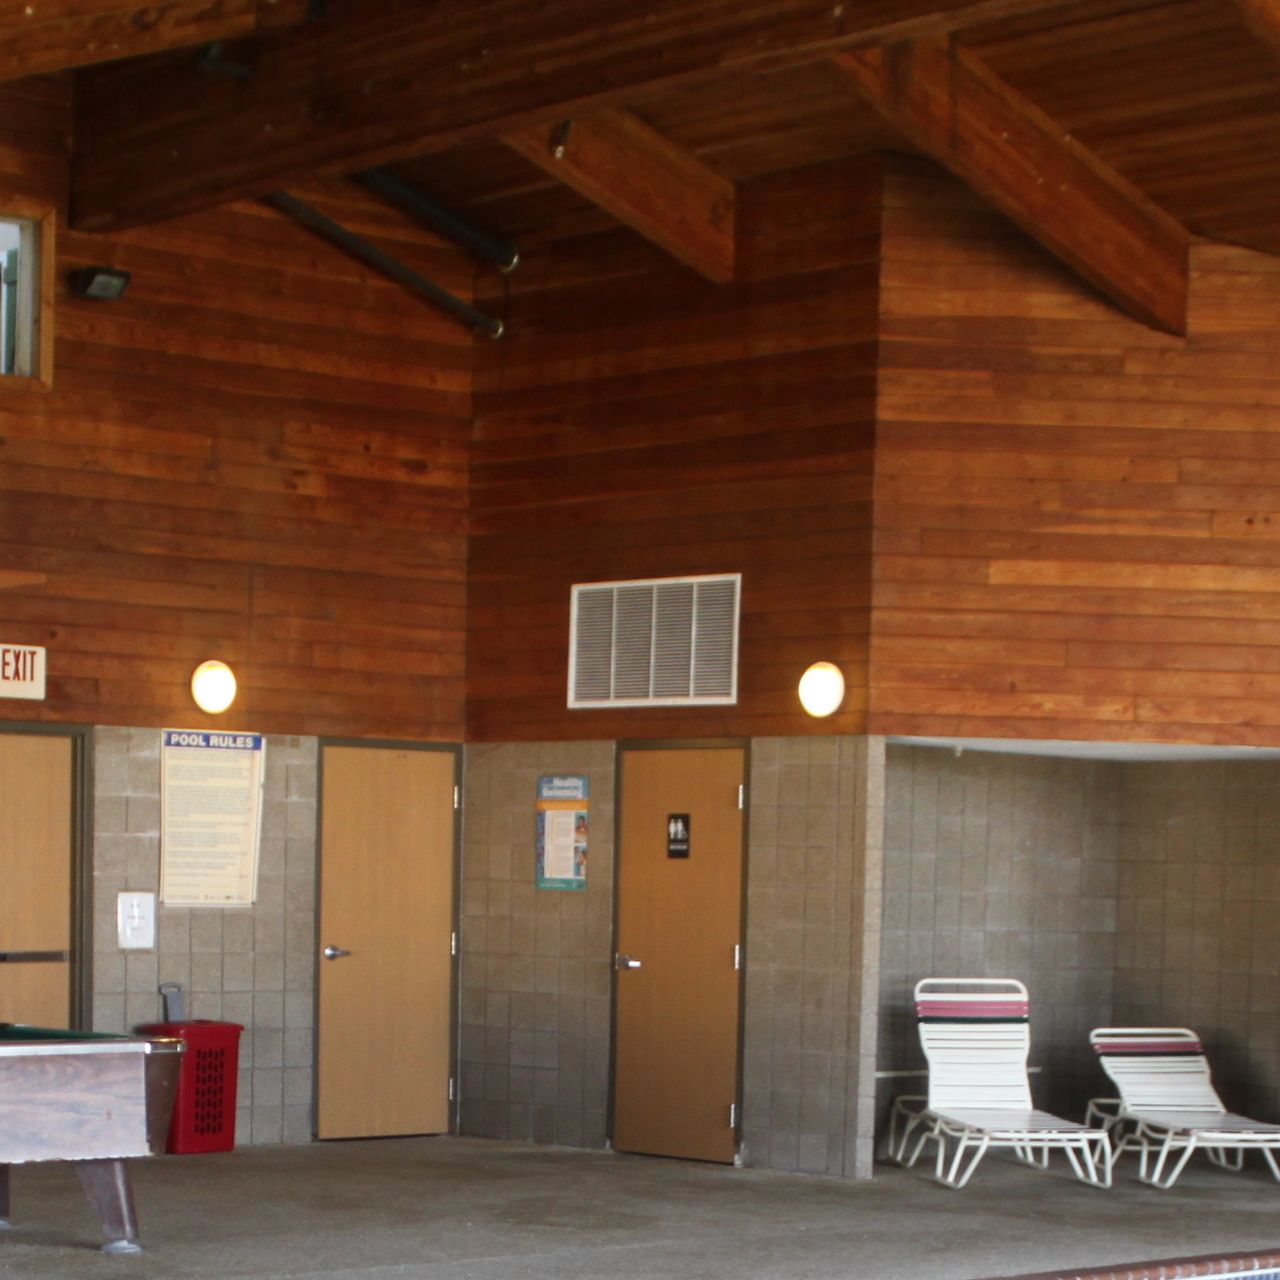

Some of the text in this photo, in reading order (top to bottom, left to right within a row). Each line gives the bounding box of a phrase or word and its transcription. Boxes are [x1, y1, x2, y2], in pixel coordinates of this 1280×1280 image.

[2, 648, 37, 682] EXIT
[170, 733, 254, 749] POOL RULES
